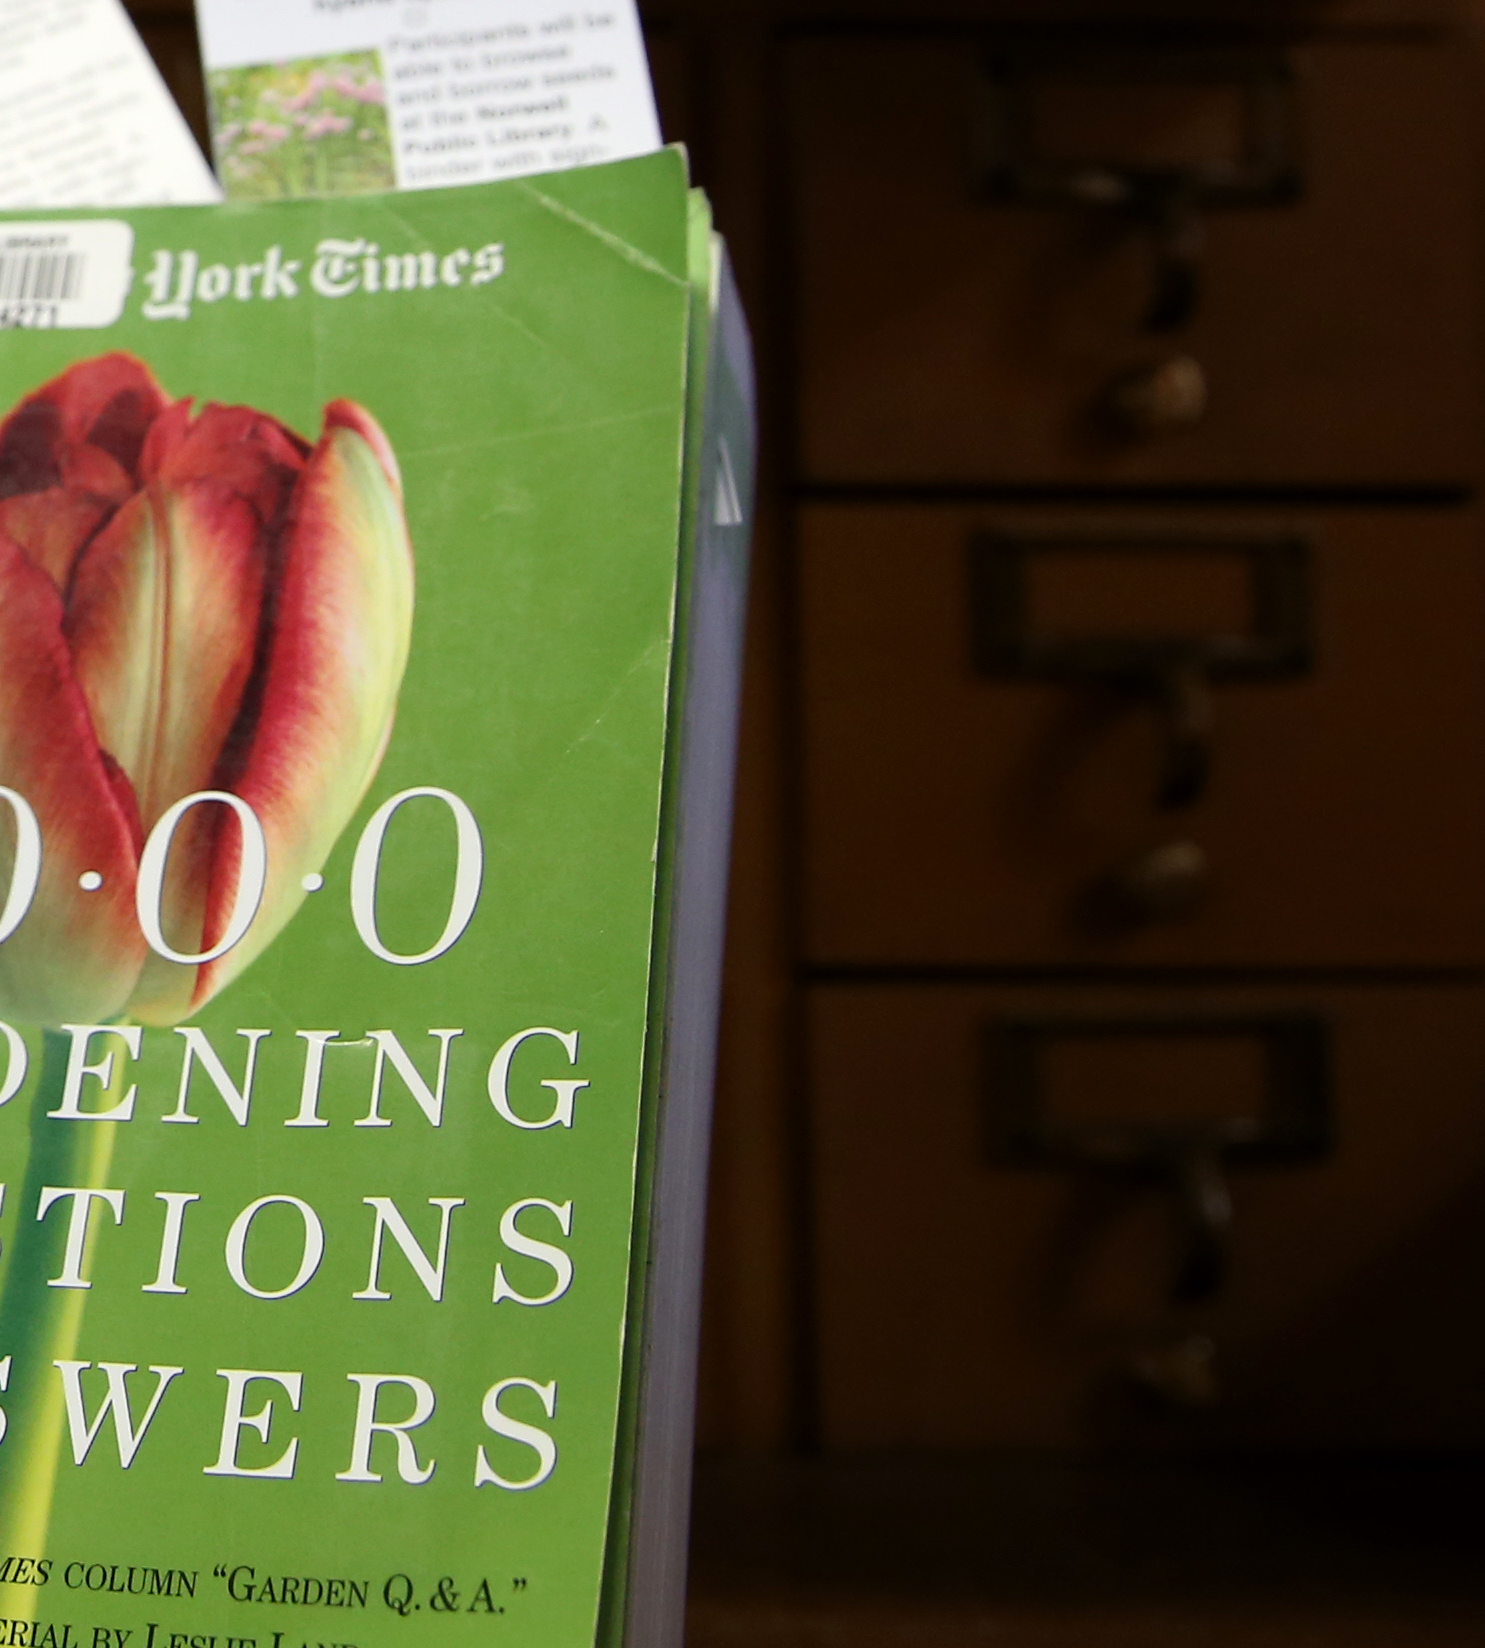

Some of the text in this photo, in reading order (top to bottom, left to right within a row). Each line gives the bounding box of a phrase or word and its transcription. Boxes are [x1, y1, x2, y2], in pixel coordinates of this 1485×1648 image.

[476, 96, 569, 121] Norwell
[142, 238, 505, 320] York Times
[65, 1562, 197, 1597] COLUMN
[384, 1575, 420, 1616] Q.
[430, 1578, 457, 1611] &
[93, 1628, 132, 1648] BY
